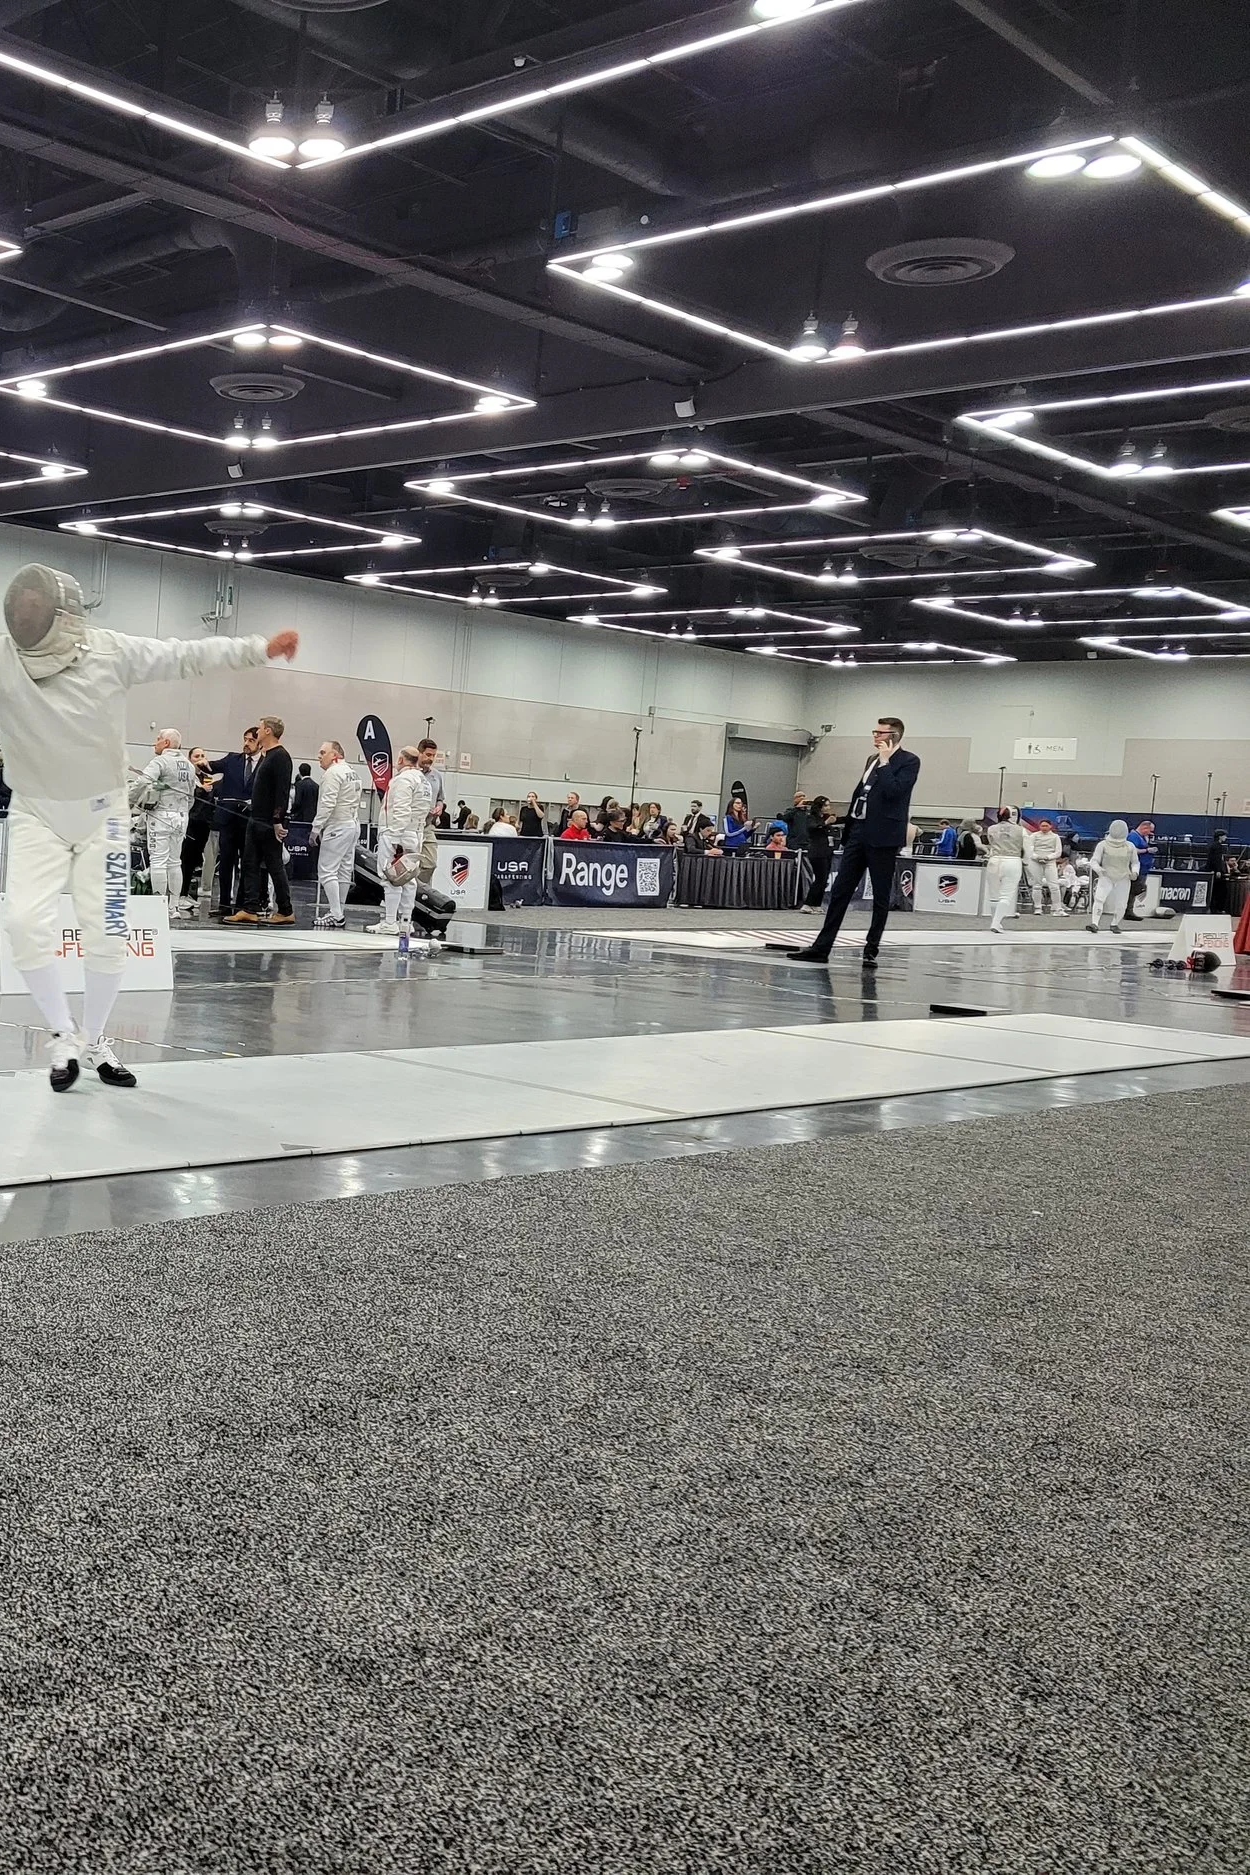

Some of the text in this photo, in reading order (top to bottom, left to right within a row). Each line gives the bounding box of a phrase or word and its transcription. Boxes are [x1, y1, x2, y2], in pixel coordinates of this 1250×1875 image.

[363, 720, 376, 740] A
[497, 861, 529, 872] USA
[559, 852, 629, 896] Range
[104, 851, 128, 939] SZATHMARY
[1160, 887, 1191, 901] macron
